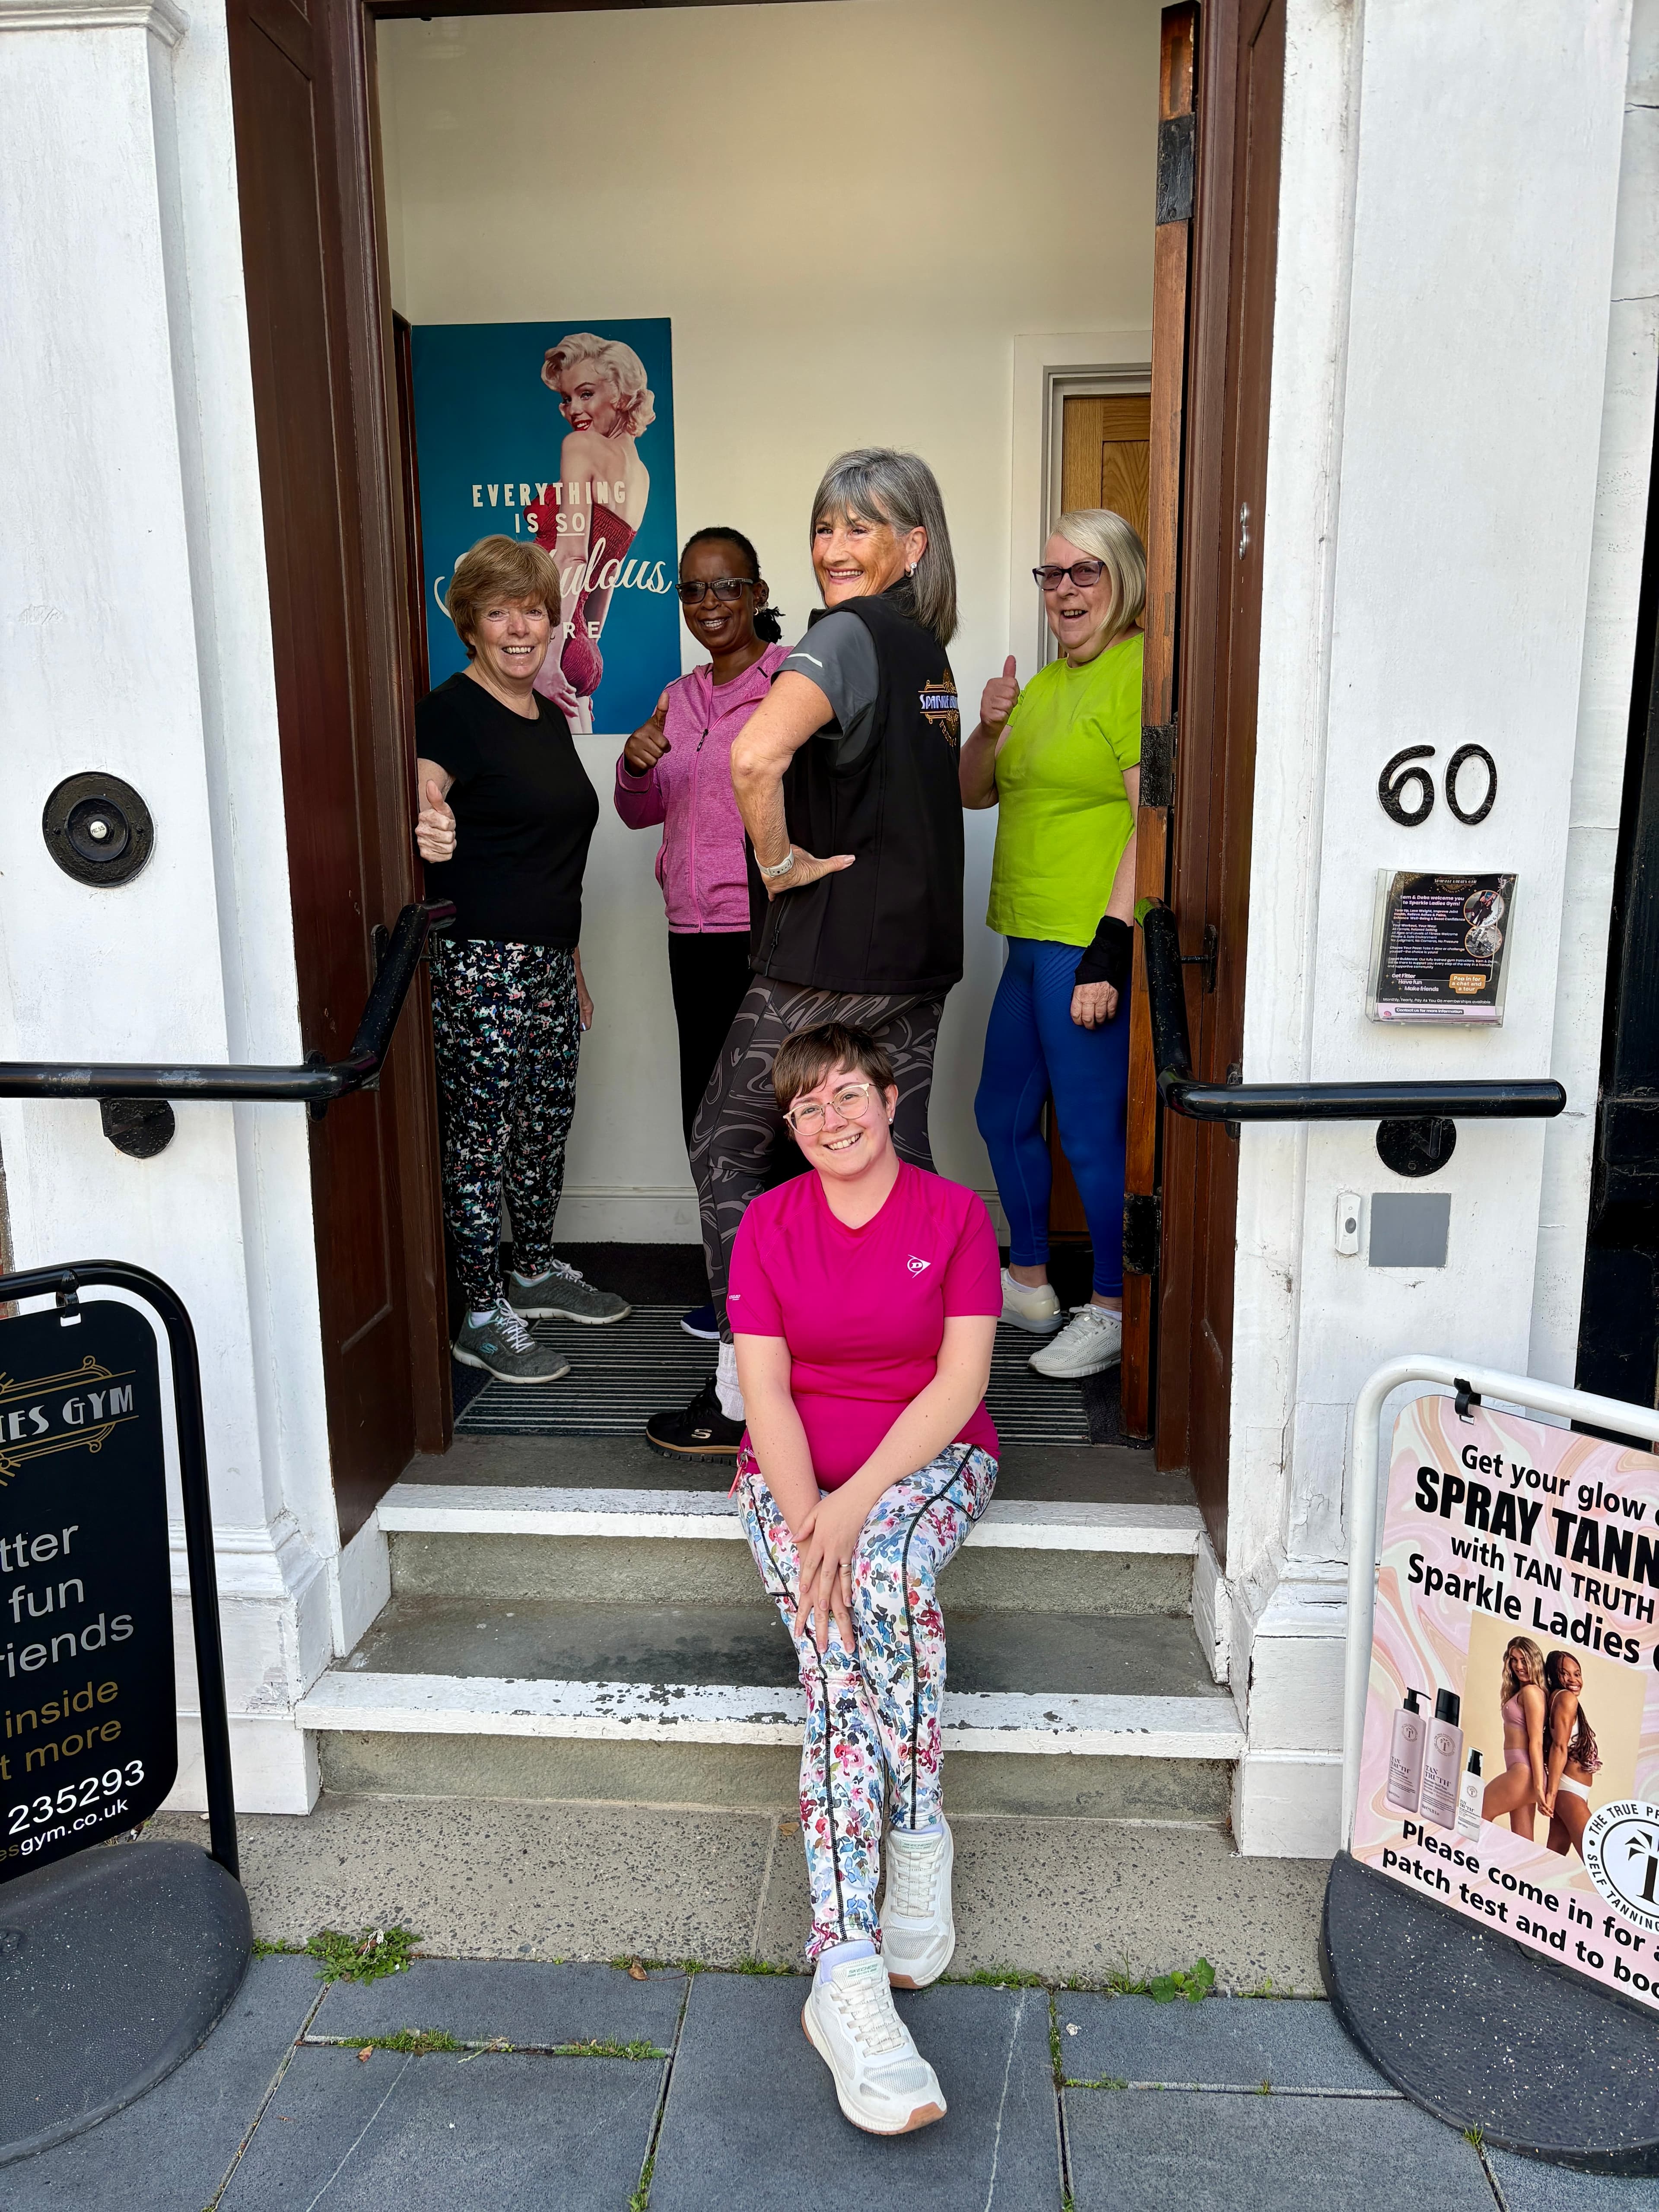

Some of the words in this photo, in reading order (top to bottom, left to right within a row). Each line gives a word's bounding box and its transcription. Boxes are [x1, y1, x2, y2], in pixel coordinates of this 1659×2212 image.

[473, 481, 626, 507] EVERYTHING
[515, 514, 538, 534] IS
[556, 512, 585, 534] SO
[1378, 744, 1497, 826] 60
[63, 1384, 133, 1424] GYM
[1462, 1444, 1504, 1478] Get
[1510, 1463, 1571, 1497] your
[1578, 1481, 1647, 1521] glow
[1415, 1466, 1543, 1546] SPRAY
[1551, 1508, 1659, 1589] TANN
[8, 1579, 84, 1624] fun
[1407, 1553, 1522, 1621] Sparkle
[1532, 1597, 1640, 1664] Ladies
[1451, 1536, 1504, 1572] with
[1513, 1553, 1562, 1592] TAN
[1570, 1573, 1655, 1624] TRUTH
[6, 1681, 118, 1738] inside
[26, 1719, 121, 1772] more
[8, 1760, 145, 1835] 235293
[1589, 1815, 1608, 1835] THE
[1606, 1804, 1639, 1818] TRUE
[1403, 1820, 1480, 1873] Please
[1489, 1867, 1559, 1912] come
[1568, 1898, 1592, 1929] in
[1603, 1916, 1646, 1952] for
[1587, 1853, 1608, 1886] SELF
[1383, 1847, 1451, 1894] patch
[1459, 1882, 1507, 1923] test
[1516, 1915, 1566, 1951] and
[1575, 1941, 1604, 1969] to
